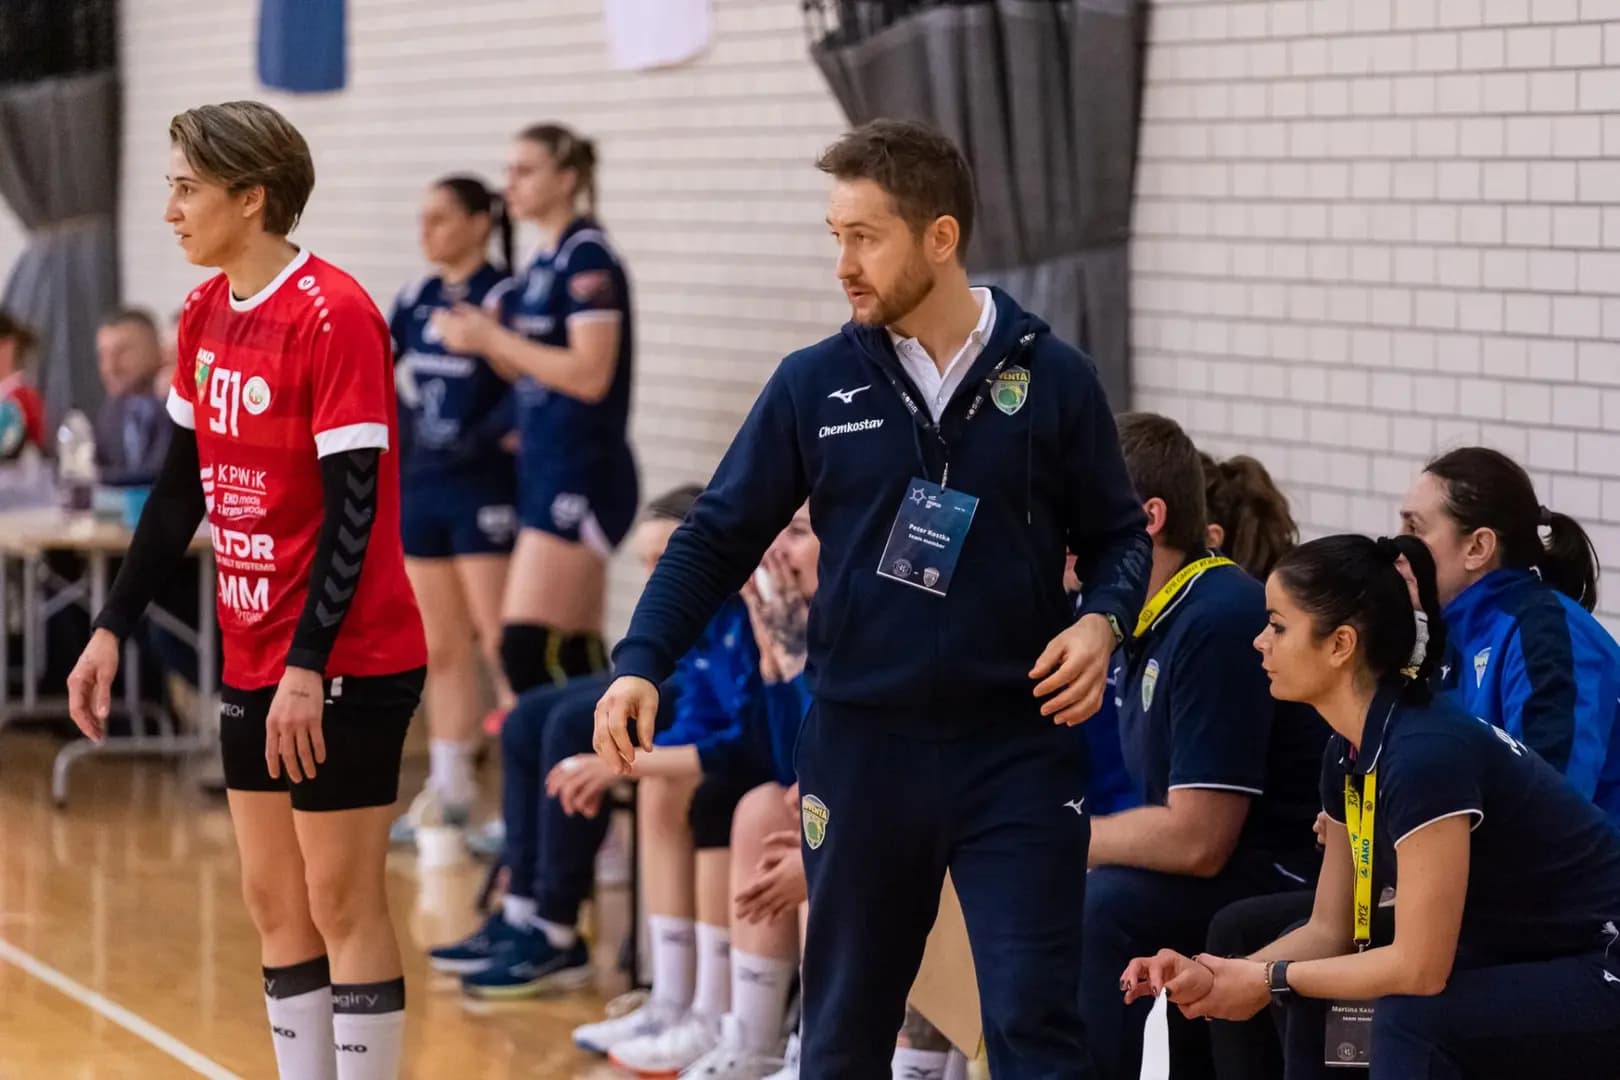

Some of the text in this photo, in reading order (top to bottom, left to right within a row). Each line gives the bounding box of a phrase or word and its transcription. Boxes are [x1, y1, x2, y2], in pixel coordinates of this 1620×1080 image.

[209, 367, 242, 437] 91
[818, 417, 884, 438] Chemkostav
[217, 464, 267, 490] KPWiK
[908, 523, 951, 542] Peter Kostka
[1361, 839, 1370, 865] JAKO
[1332, 1005, 1358, 1013] Martina
